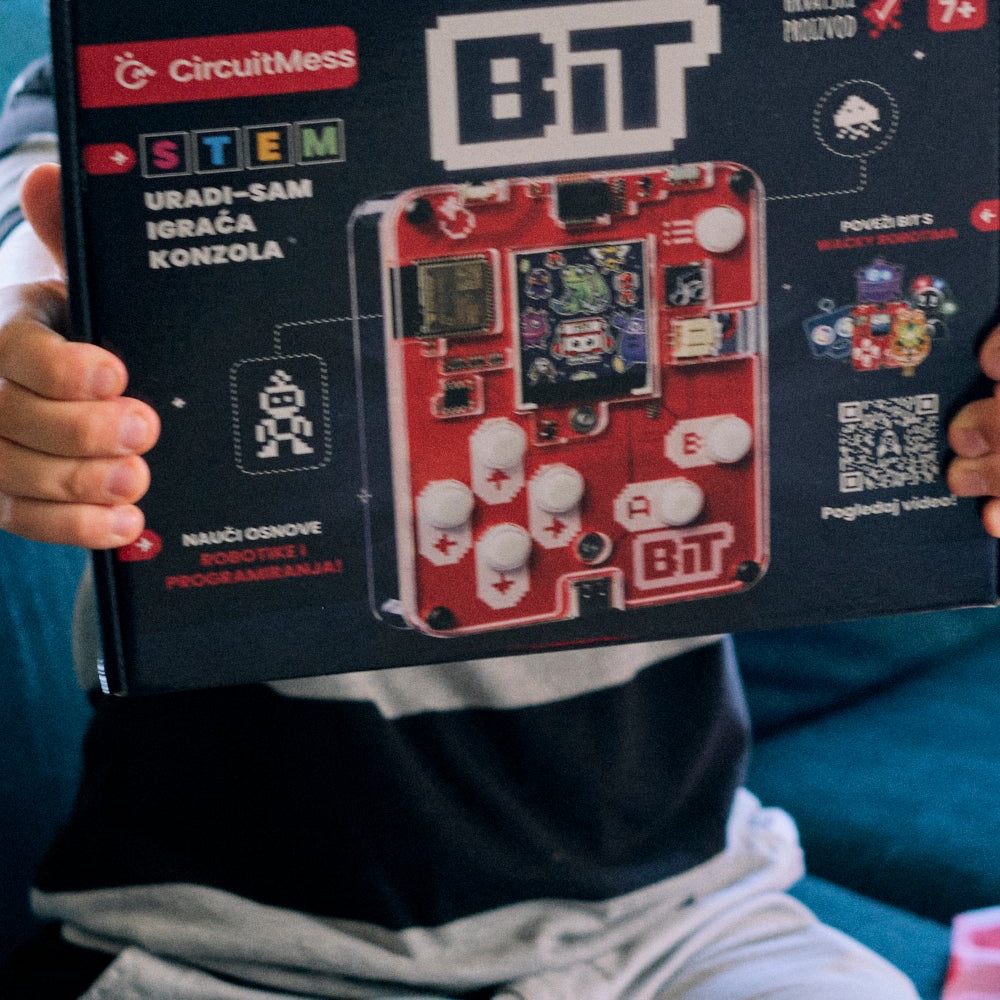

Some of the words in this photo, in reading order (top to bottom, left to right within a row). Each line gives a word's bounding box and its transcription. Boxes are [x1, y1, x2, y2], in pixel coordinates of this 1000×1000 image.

[937, 0, 976, 23] 7+
[168, 49, 356, 82] CircuitMess
[151, 126, 338, 170] STEM
[144, 179, 313, 211] URADI-SAM
[145, 209, 257, 240] IGRAČA
[149, 240, 285, 269] KONZOLA
[182, 526, 243, 547] NAUČI
[244, 520, 322, 540] OSNOVE
[200, 545, 296, 567] ROBOTIKE
[165, 559, 343, 589] PROGRAMIRANJA!
